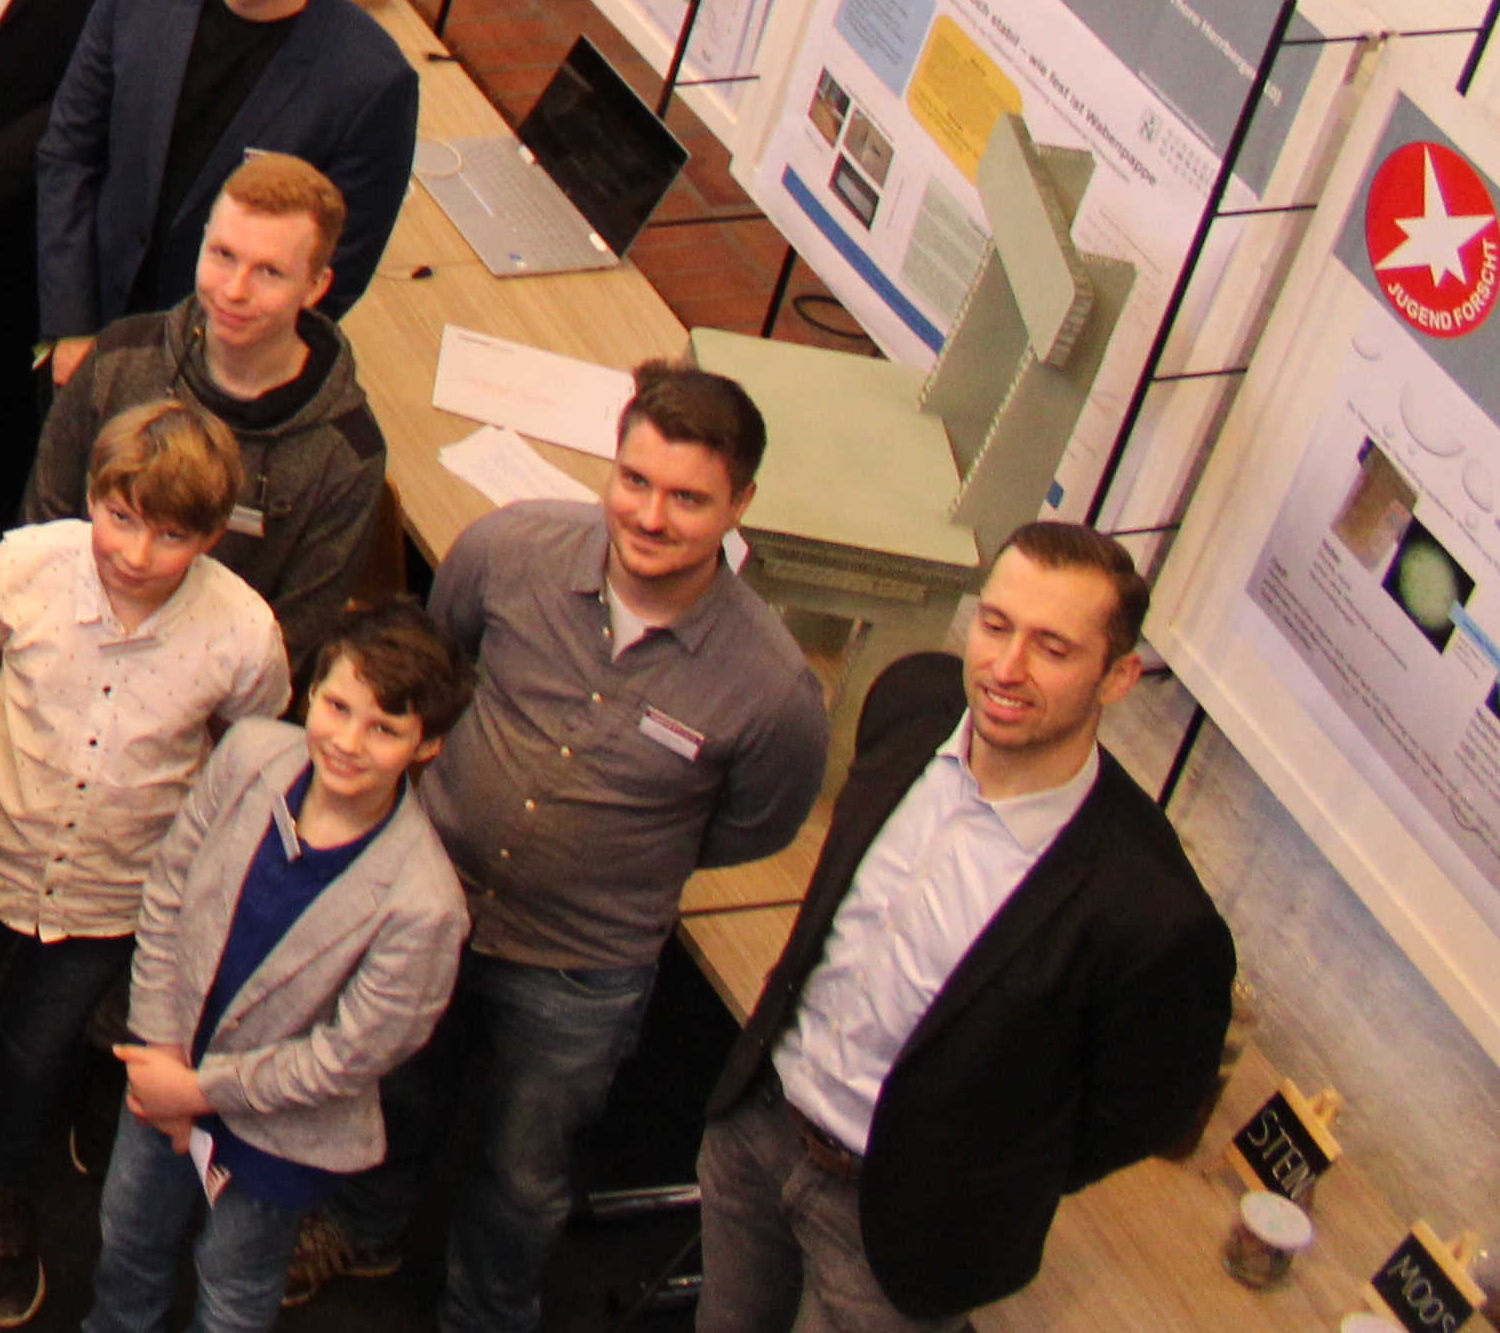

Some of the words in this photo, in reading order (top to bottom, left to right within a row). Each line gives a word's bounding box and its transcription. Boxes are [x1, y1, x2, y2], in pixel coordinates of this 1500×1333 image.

[1028, 53, 1049, 77] wie
[1085, 110, 1158, 187] Wabenpappe
[1387, 282, 1452, 330] JUGEND
[1452, 237, 1497, 328] FORSCHT
